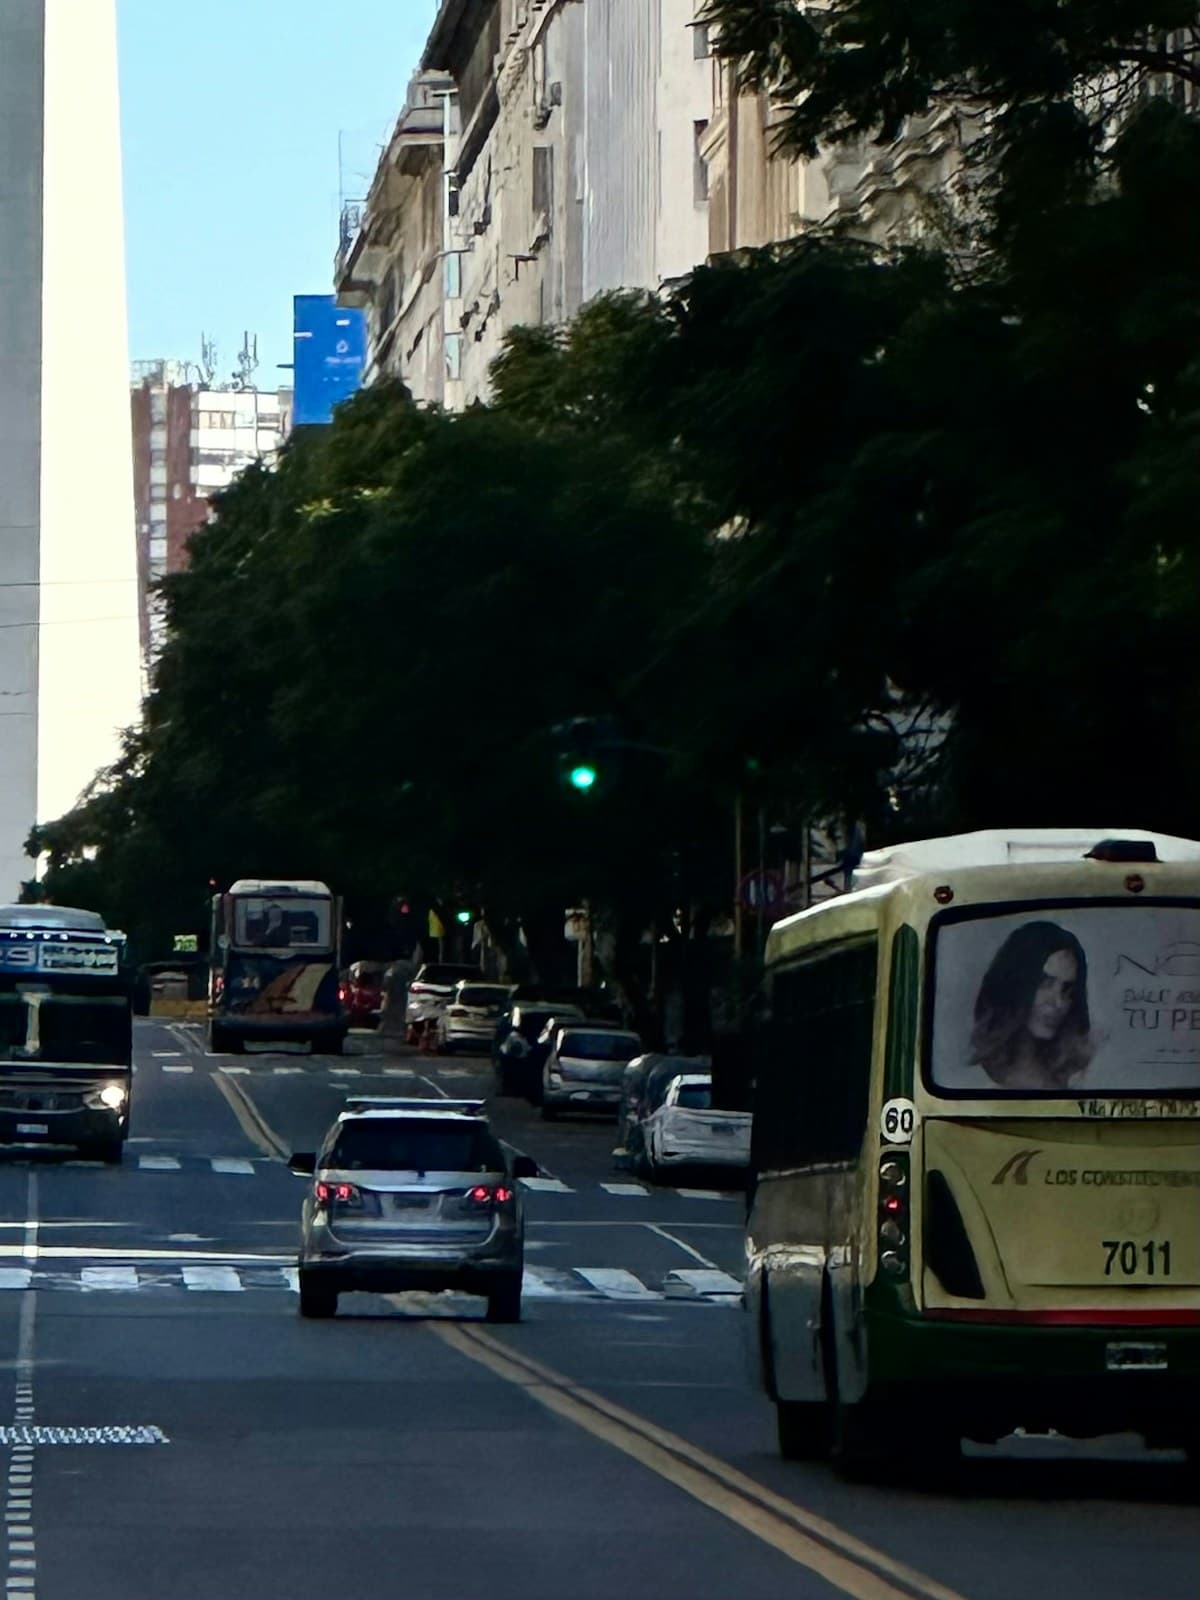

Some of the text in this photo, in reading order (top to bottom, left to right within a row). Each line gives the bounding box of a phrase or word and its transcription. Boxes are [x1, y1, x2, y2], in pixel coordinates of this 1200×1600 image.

[886, 1107, 913, 1134] 60
[1044, 1169, 1077, 1186] LOS
[1102, 1240, 1171, 1276] 7011
